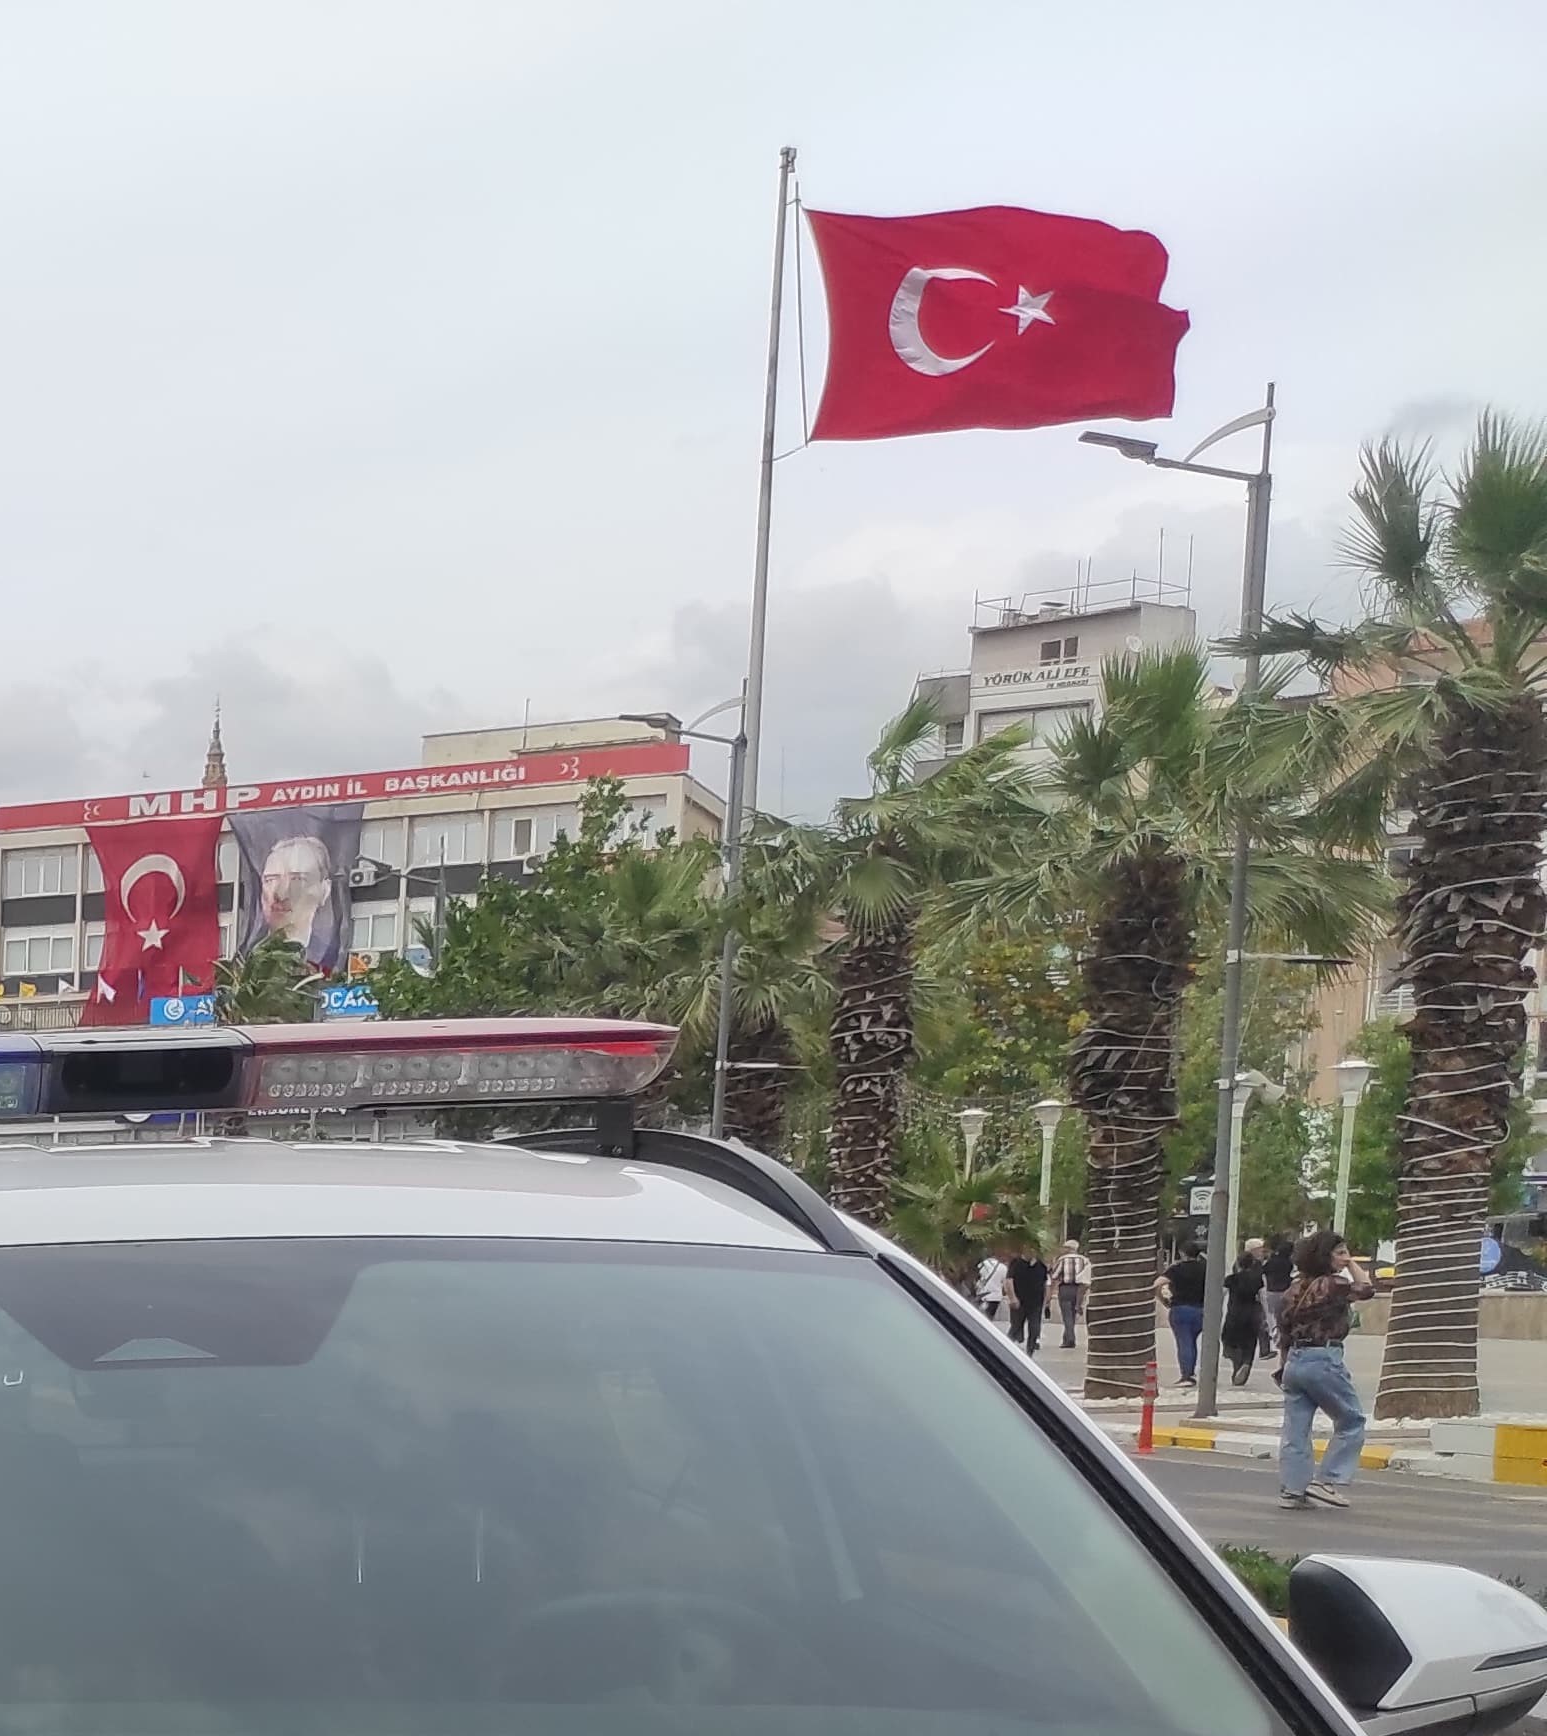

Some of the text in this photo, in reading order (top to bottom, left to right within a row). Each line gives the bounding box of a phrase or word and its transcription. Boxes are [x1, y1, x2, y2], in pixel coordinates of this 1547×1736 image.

[982, 665, 1091, 687] YÖRÜK ALİ EFE
[128, 764, 527, 817] MHP AYDIN İL BAŞKANLIĞI
